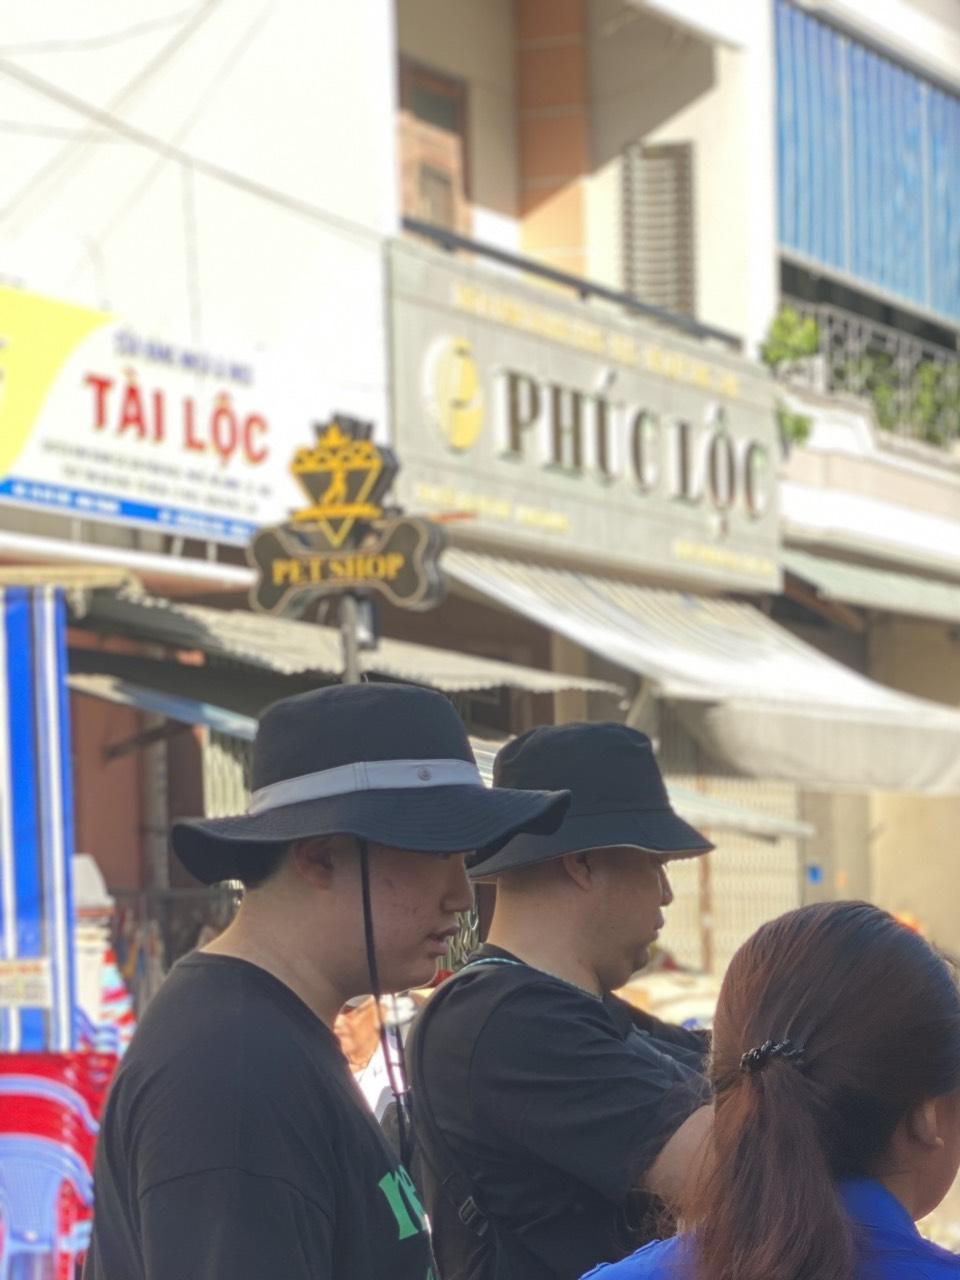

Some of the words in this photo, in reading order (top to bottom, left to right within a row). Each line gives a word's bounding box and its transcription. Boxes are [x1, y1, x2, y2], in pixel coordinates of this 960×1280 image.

[84, 368, 165, 444] TÀI
[182, 391, 270, 468] LỘC
[498, 367, 662, 494] PHÚC
[671, 402, 768, 538] LỘC
[272, 557, 322, 586] PET
[328, 552, 405, 582] SHOP
